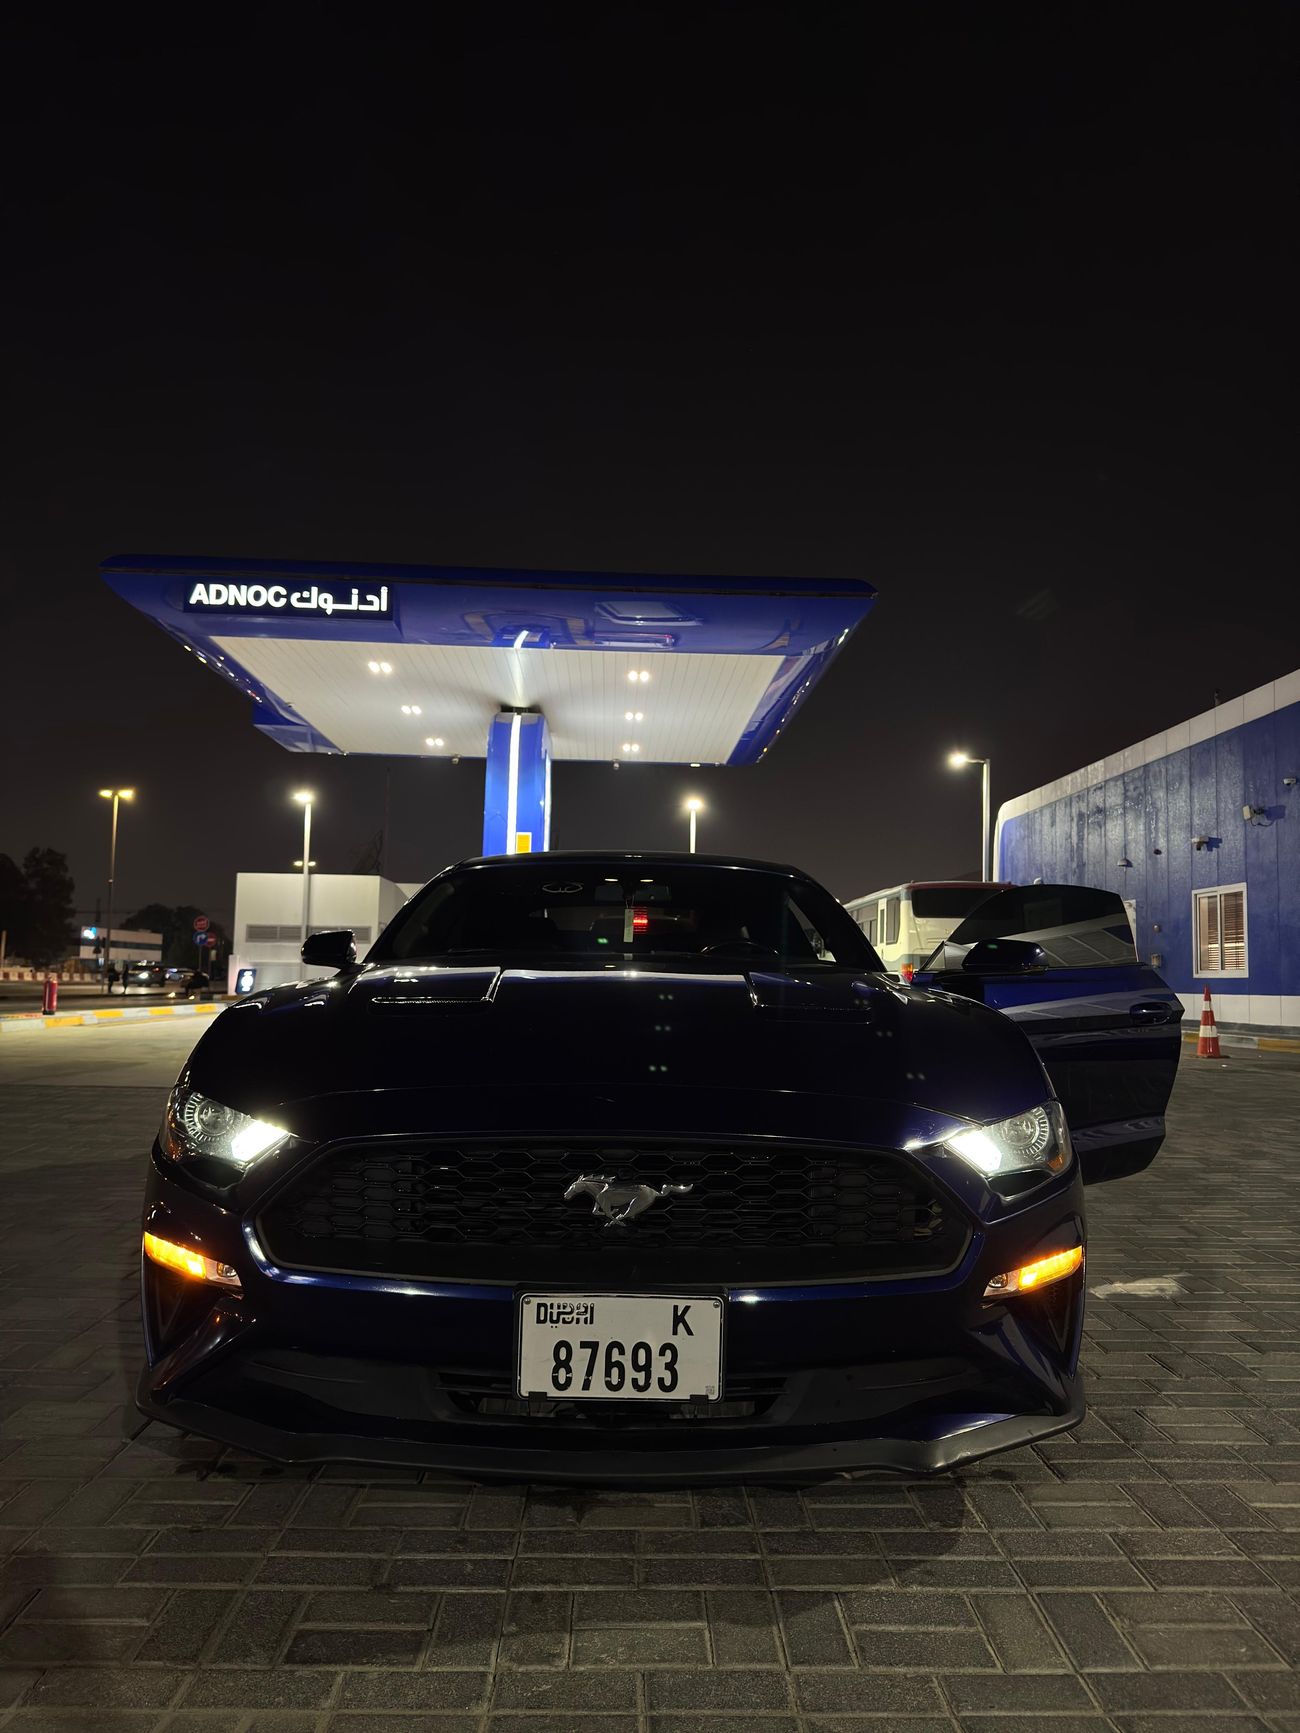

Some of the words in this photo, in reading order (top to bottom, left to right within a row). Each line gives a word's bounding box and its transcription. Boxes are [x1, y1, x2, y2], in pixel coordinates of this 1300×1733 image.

[189, 583, 288, 608] ADNOC
[671, 1304, 694, 1336] K
[551, 1339, 679, 1393] 87693
